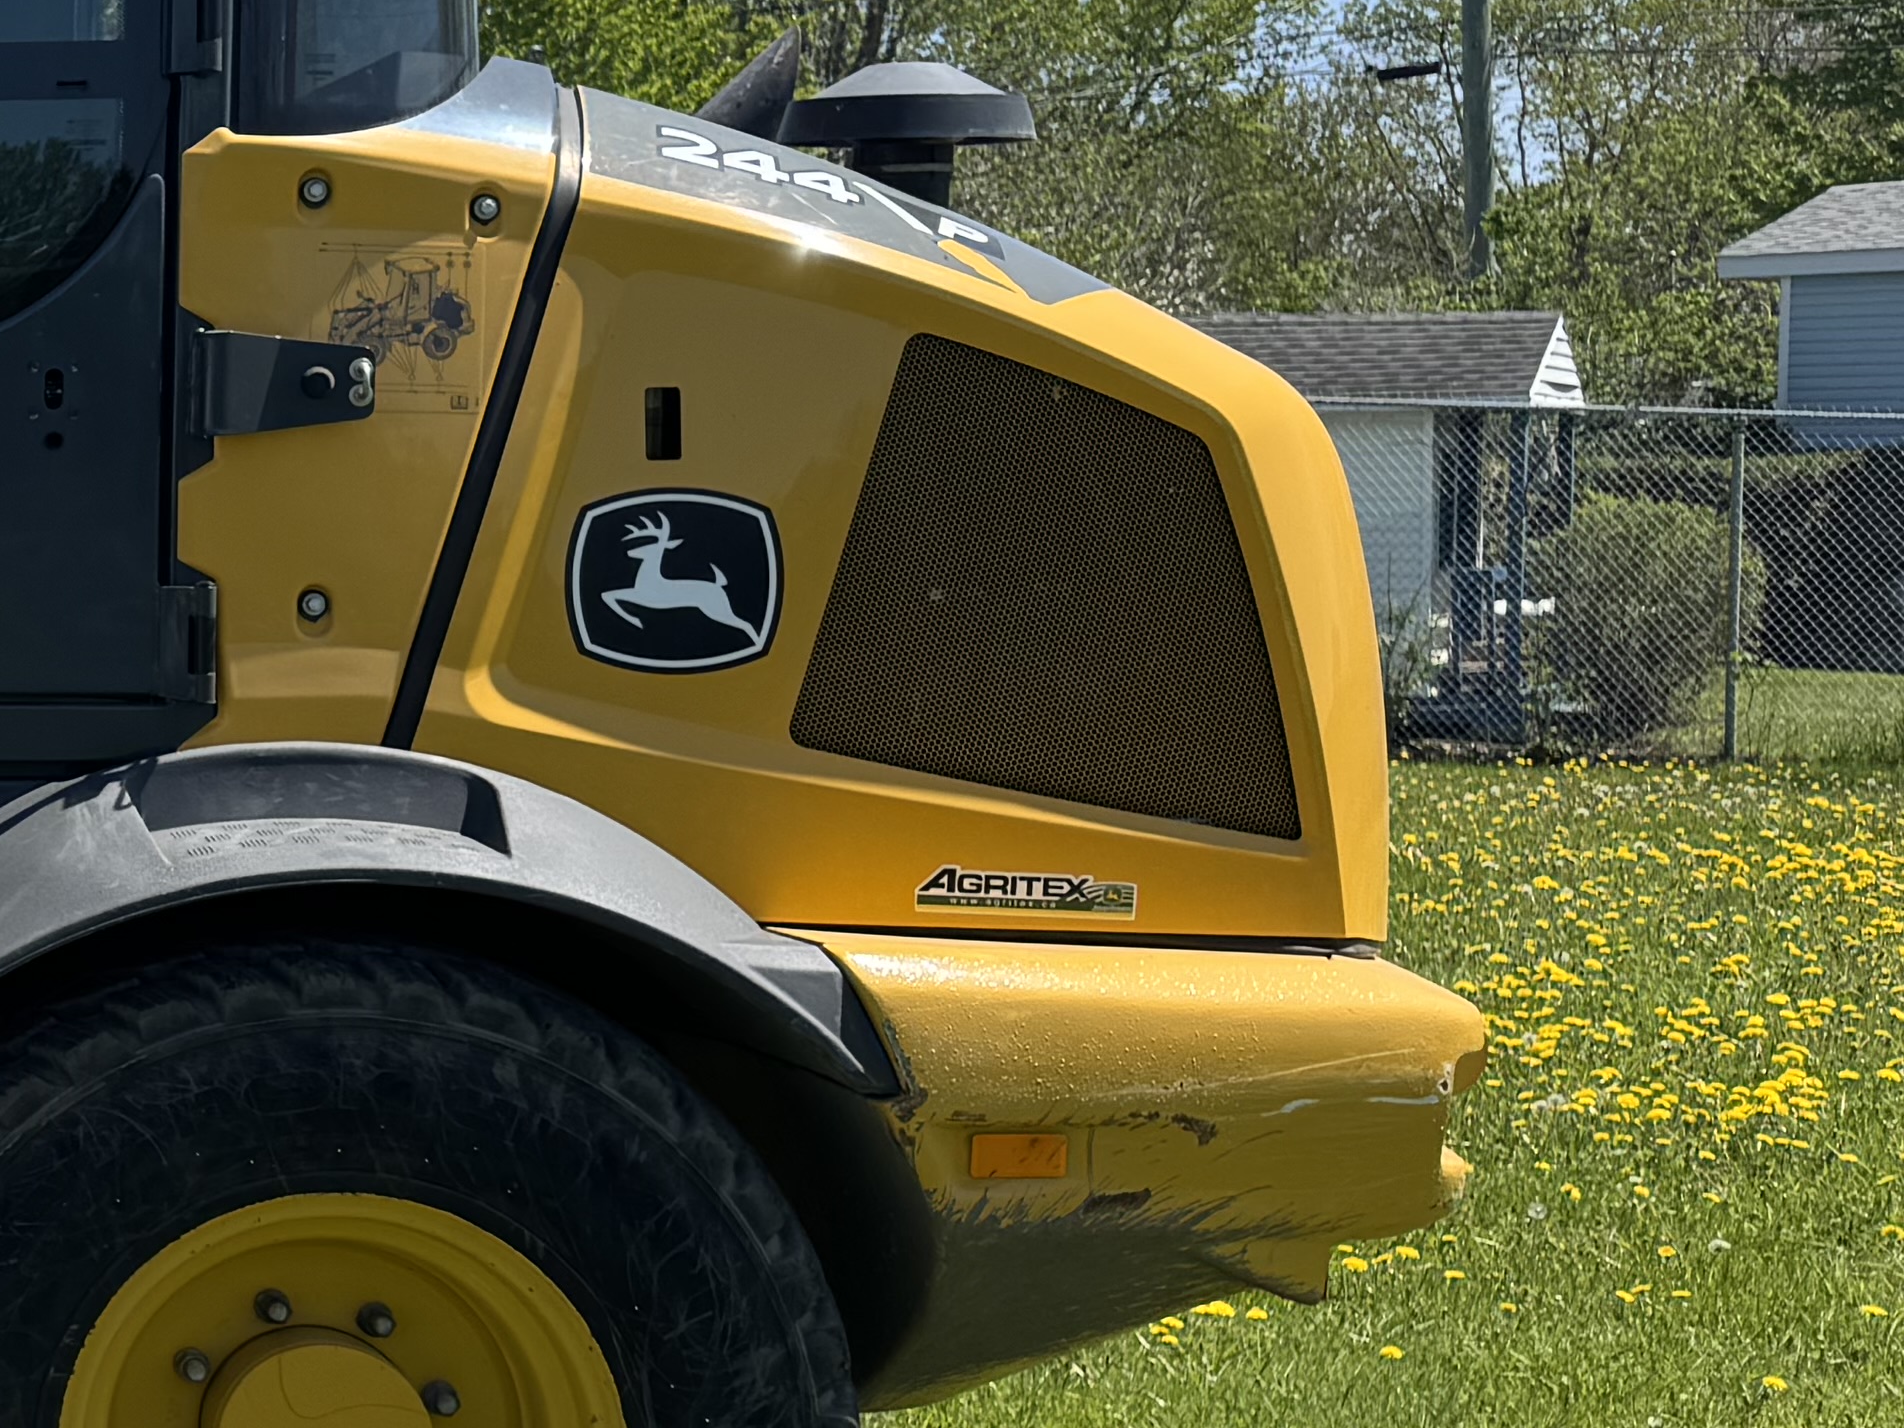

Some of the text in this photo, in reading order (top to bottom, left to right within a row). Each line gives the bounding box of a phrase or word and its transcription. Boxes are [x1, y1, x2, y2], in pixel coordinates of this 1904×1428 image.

[660, 126, 990, 244] 244 P
[918, 868, 1090, 901] AGRITEX
